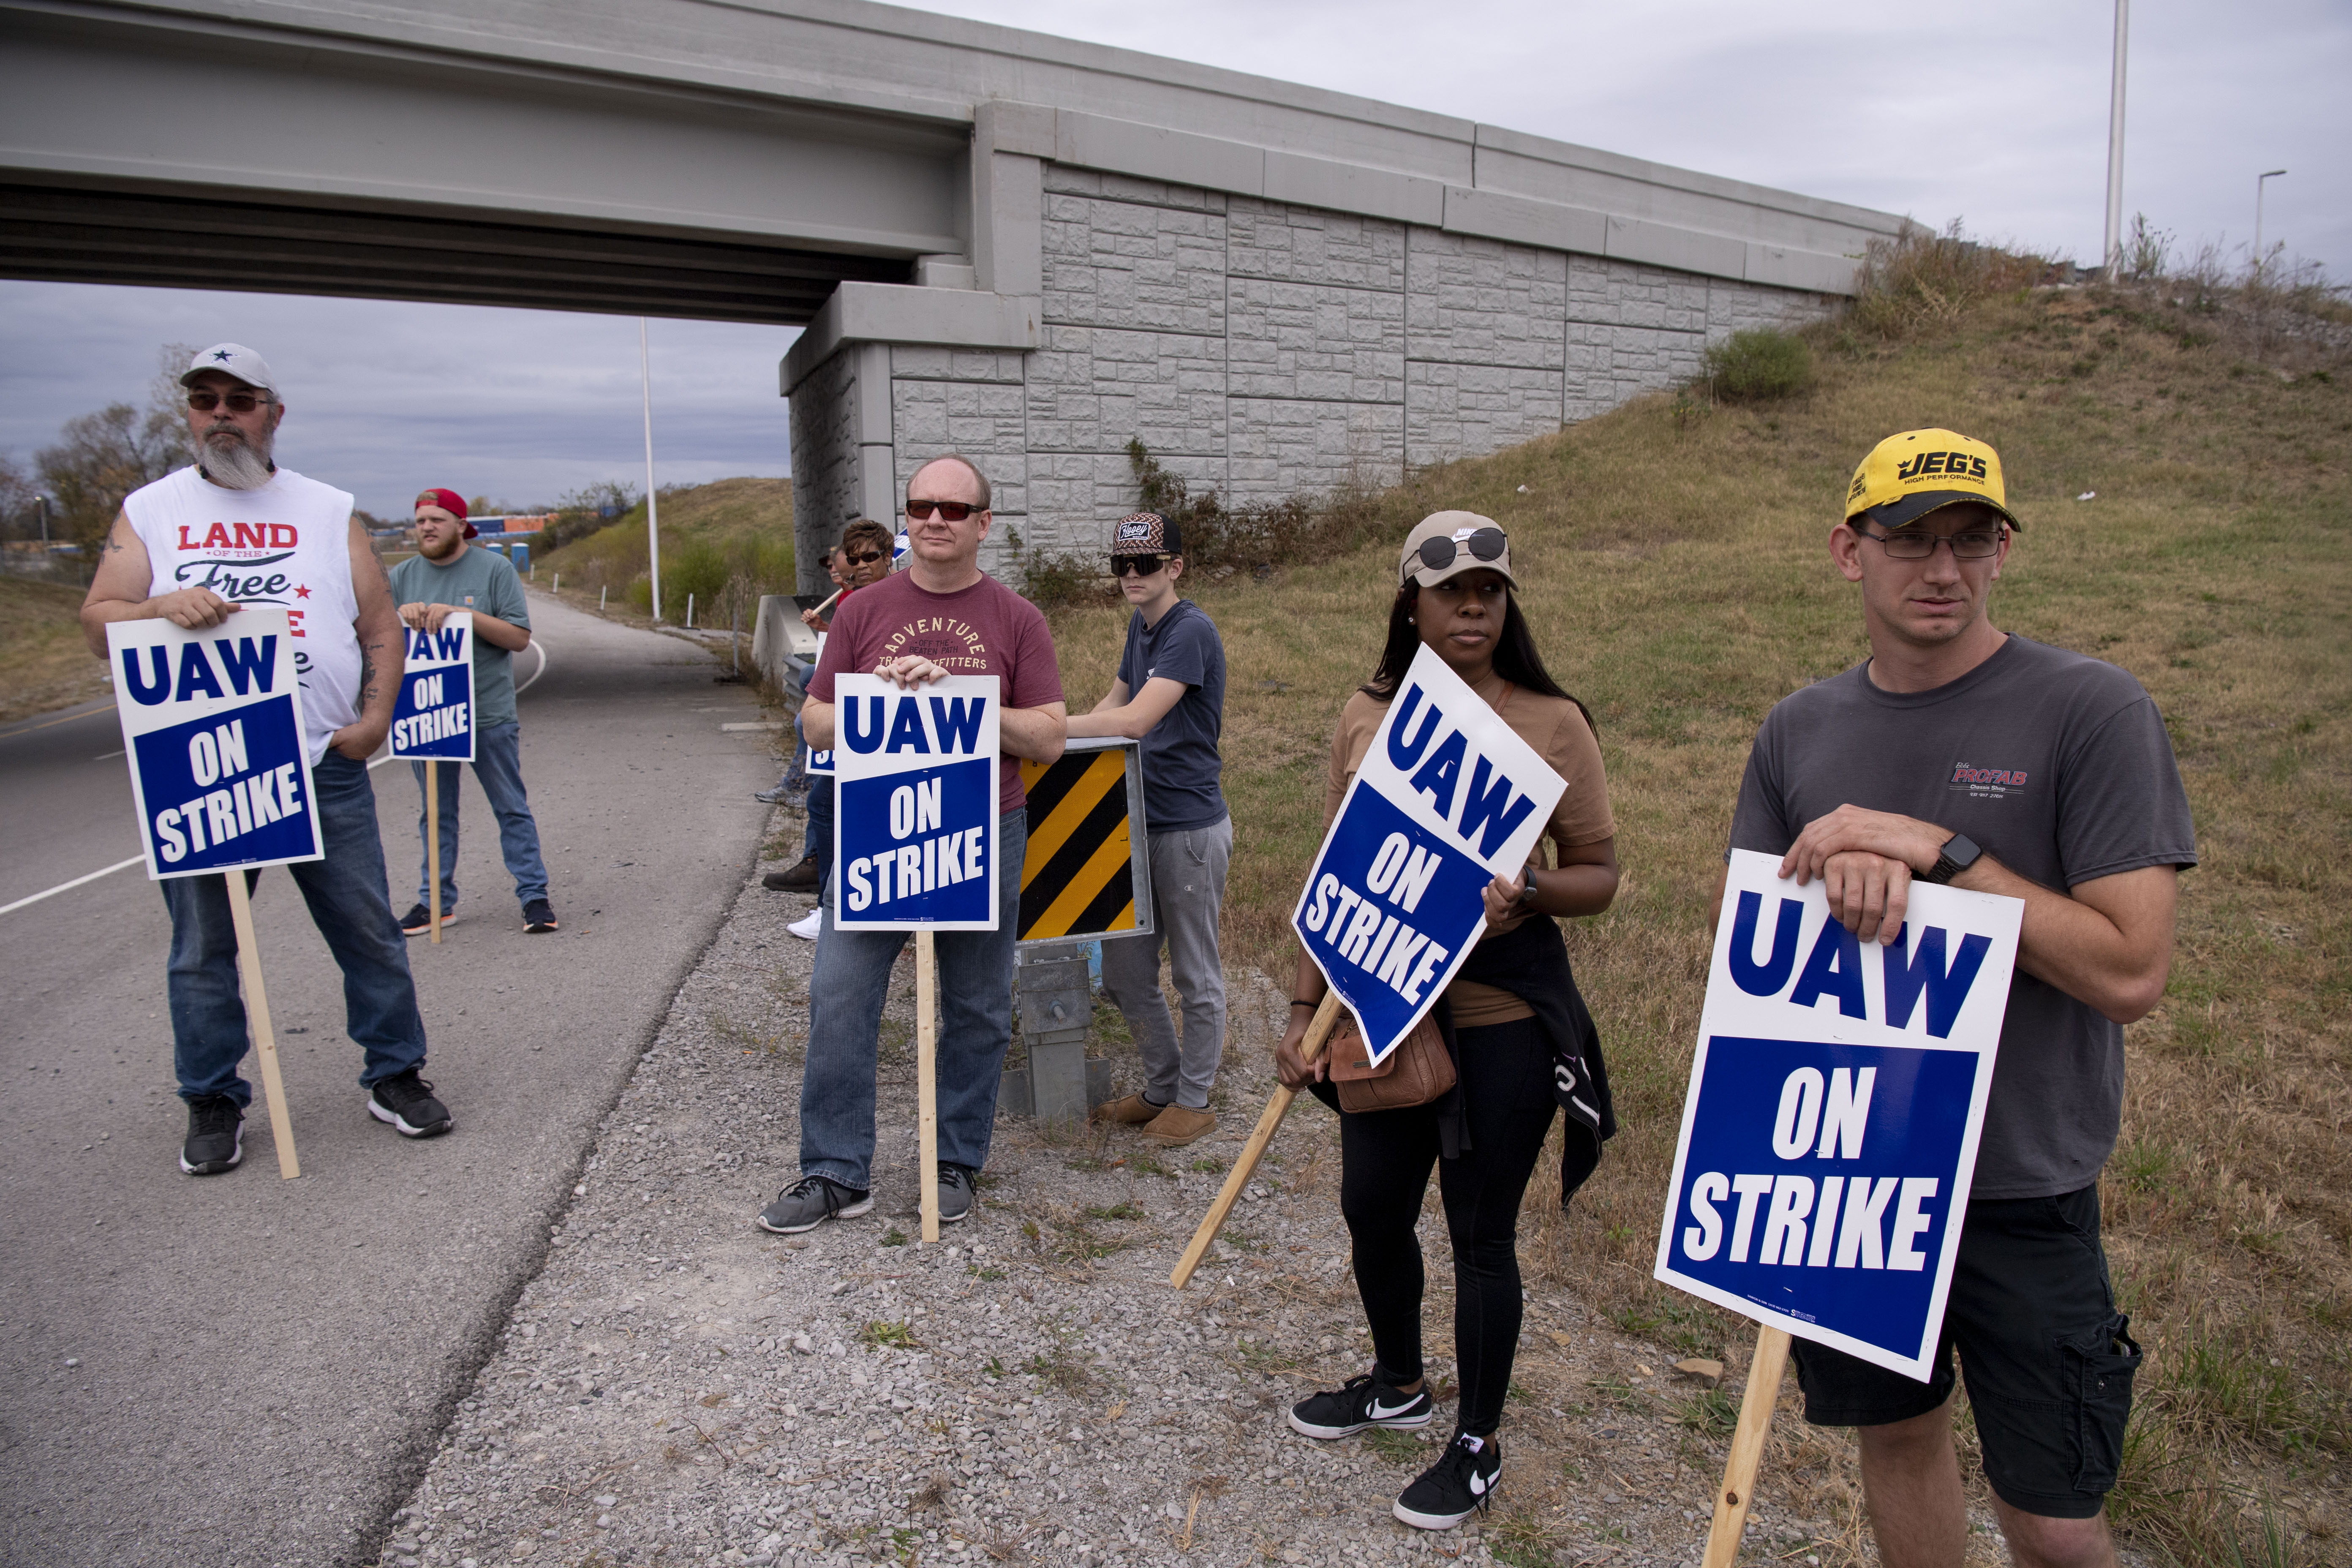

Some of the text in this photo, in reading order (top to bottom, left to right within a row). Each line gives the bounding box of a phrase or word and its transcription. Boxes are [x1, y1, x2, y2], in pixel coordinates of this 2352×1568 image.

[1898, 452, 1986, 480] JEG'S
[1905, 474, 1985, 486] HIGH PERFORMANCE
[177, 523, 298, 550] LAND
[1121, 523, 1147, 539] Hooey
[174, 551, 295, 598] Free
[885, 618, 985, 654] ADVENTURE
[909, 646, 938, 655] BEATEN
[121, 634, 277, 706] UAW
[414, 673, 444, 710] ON
[188, 719, 249, 787] ON
[394, 702, 468, 751] STRIKE
[844, 695, 986, 754] UAW
[1387, 682, 1537, 861] UAW
[1951, 768, 2027, 785] PROFAB
[155, 762, 302, 863] STRIKE
[890, 777, 941, 840] ON
[848, 825, 983, 912] STRIKE
[1367, 832, 1443, 914] ON
[1305, 873, 1449, 1006] STRIKE
[1728, 890, 1993, 1040] UAW
[1772, 1066, 1876, 1160] ON
[1683, 1171, 1939, 1271] STRIKE
